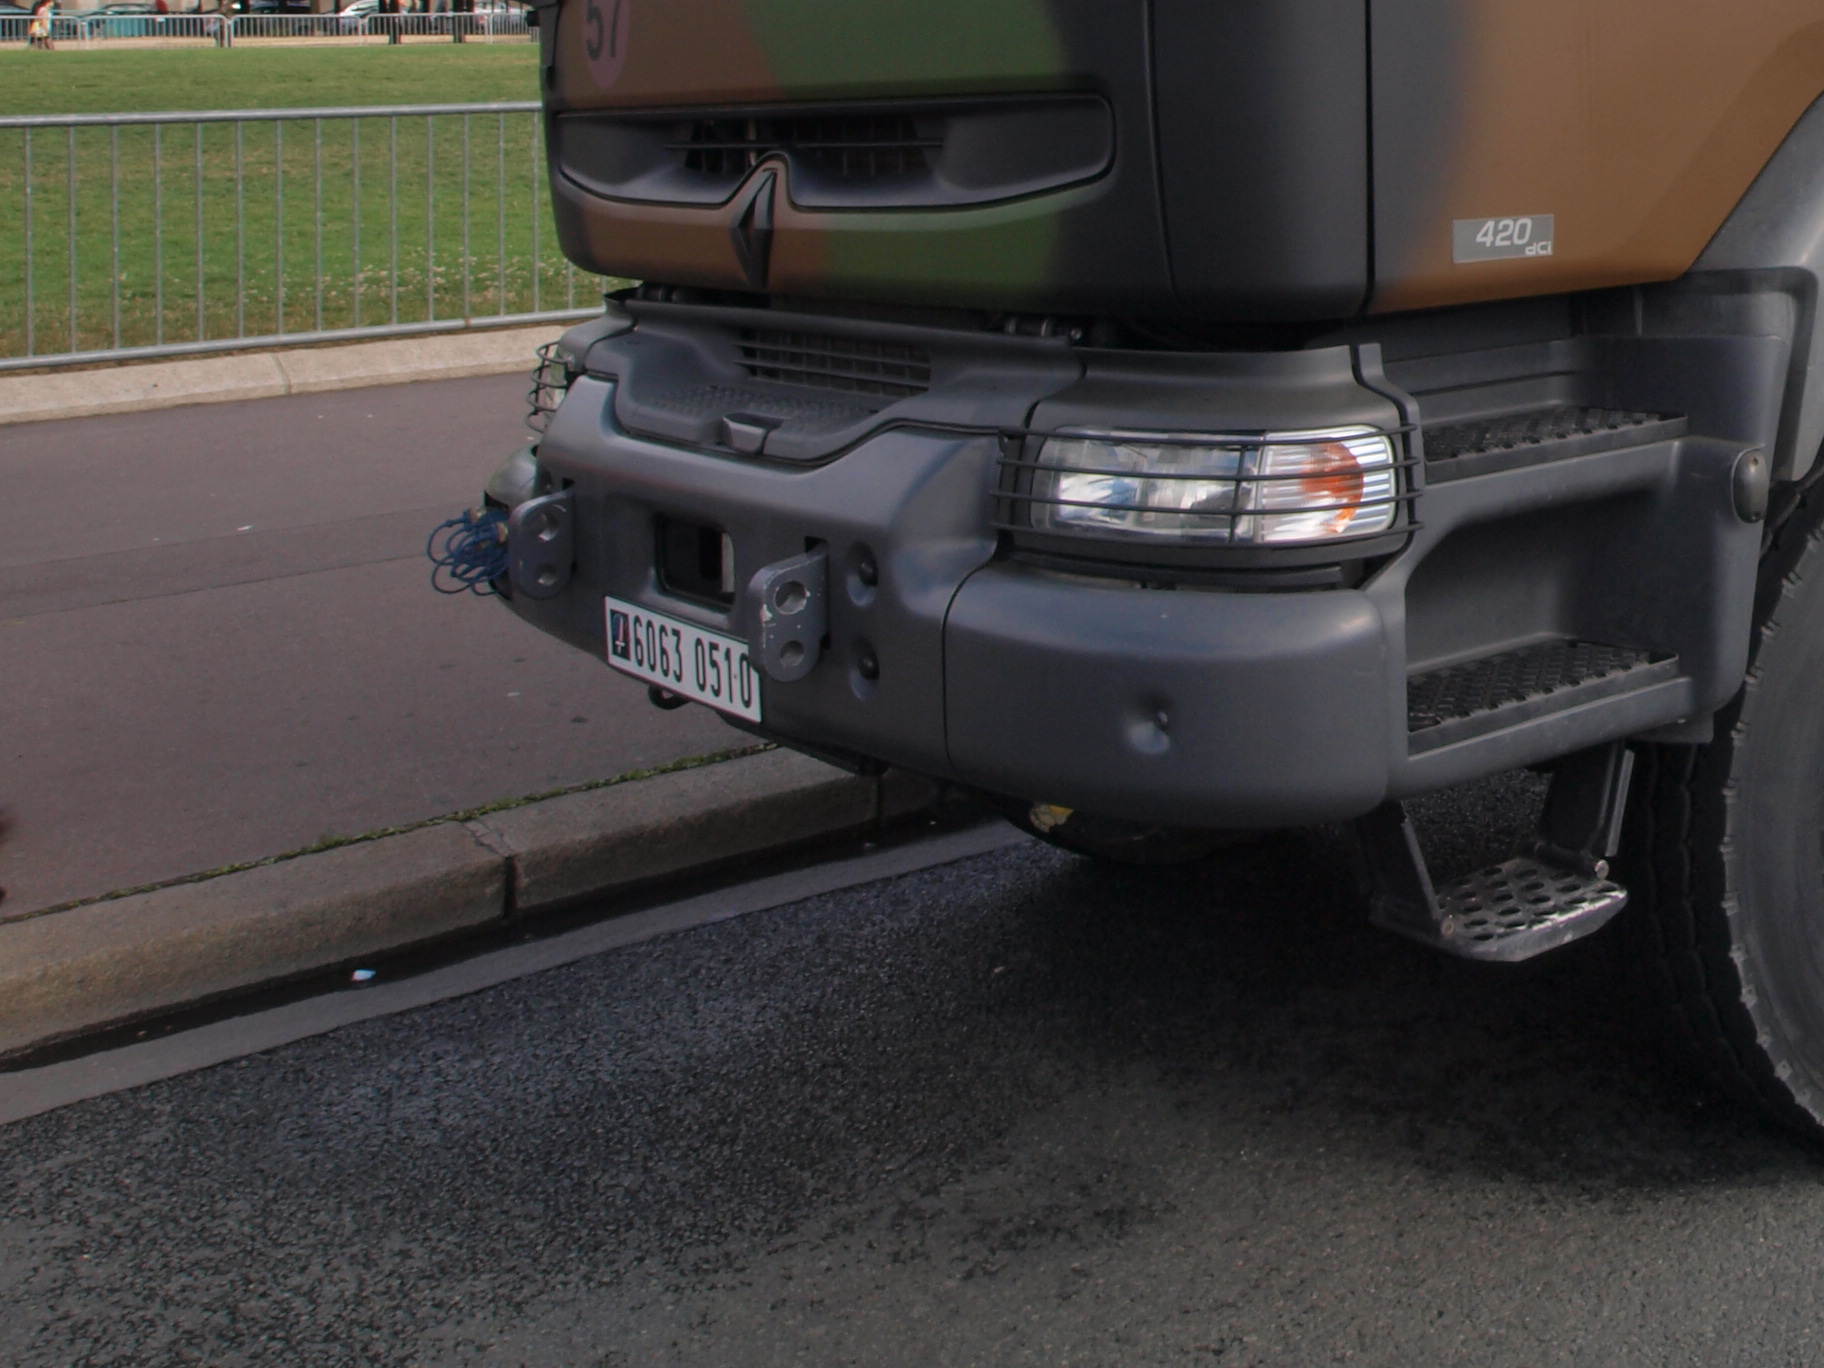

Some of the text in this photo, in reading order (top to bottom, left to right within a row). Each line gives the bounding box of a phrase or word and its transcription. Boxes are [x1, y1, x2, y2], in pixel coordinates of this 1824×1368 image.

[1476, 218, 1532, 247] 420
[633, 614, 752, 708] 6063 0510
